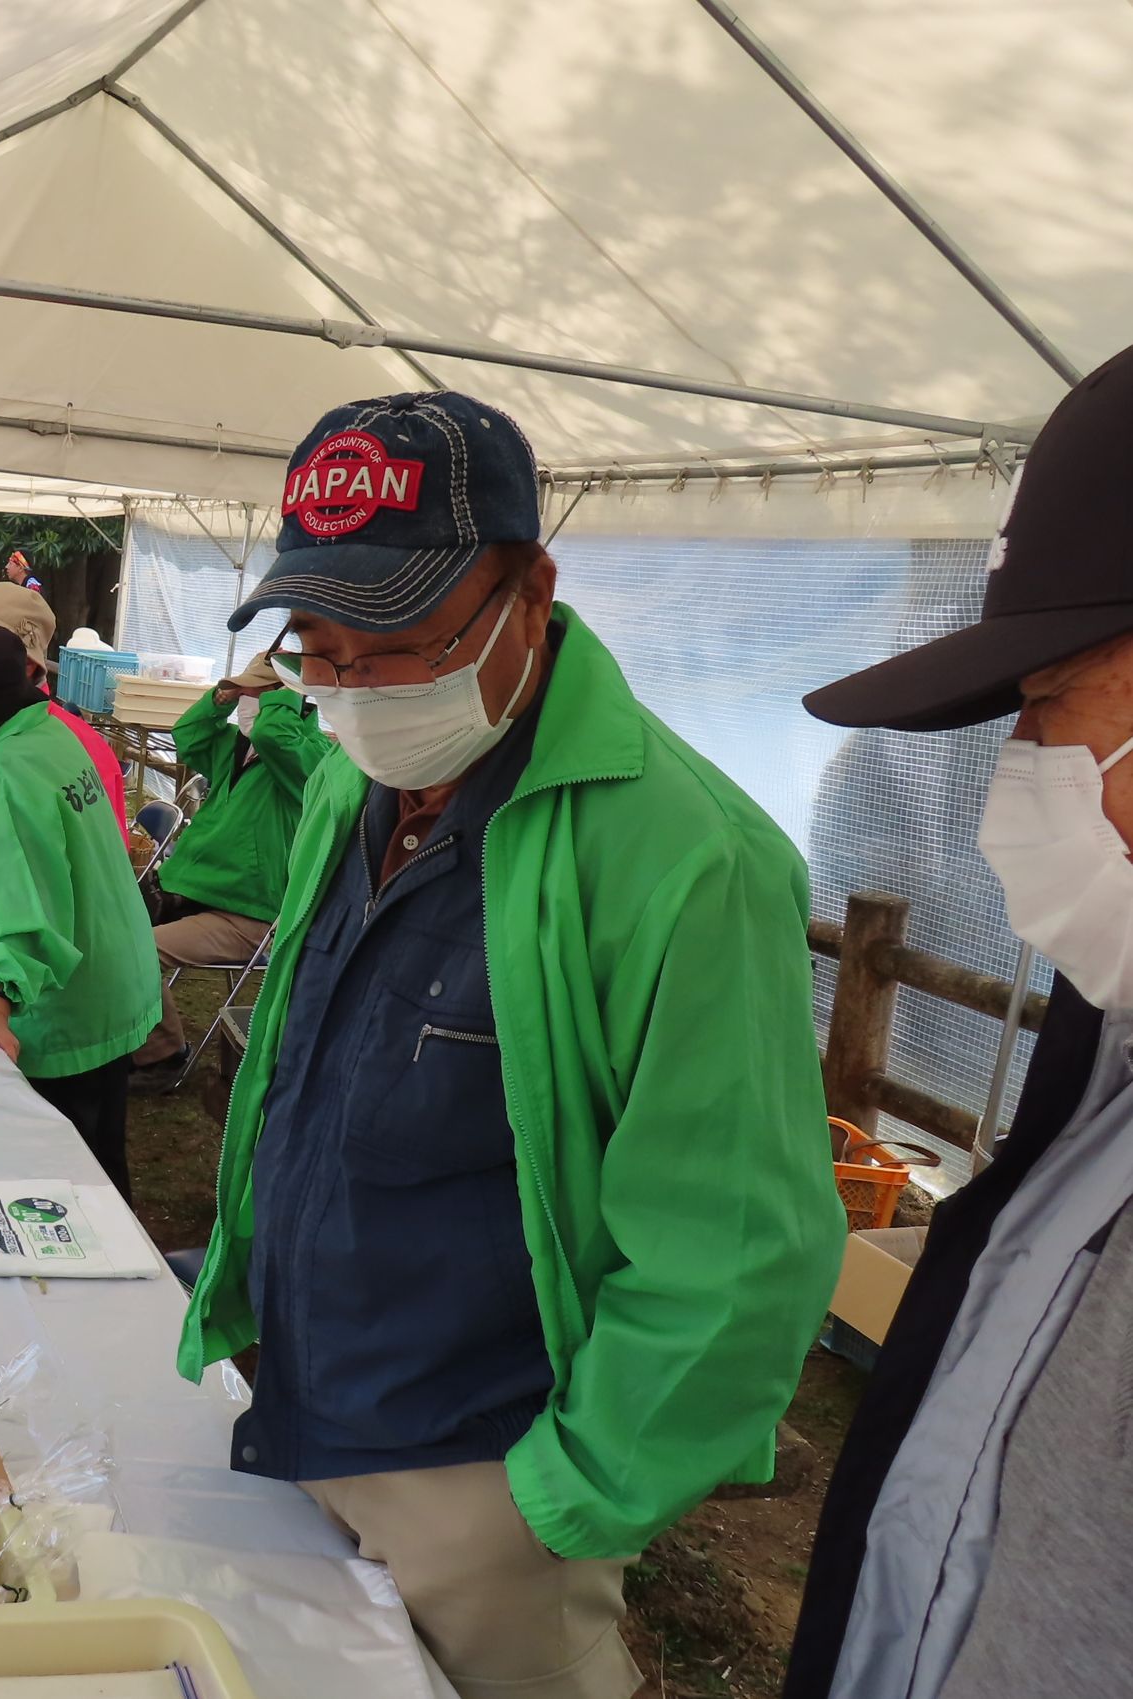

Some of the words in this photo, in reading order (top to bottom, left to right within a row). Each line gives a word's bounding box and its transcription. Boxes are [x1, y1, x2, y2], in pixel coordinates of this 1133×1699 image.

[310, 448, 327, 468] THE
[328, 436, 375, 453] COUNTRY
[370, 450, 382, 464] OF
[287, 466, 409, 505] JAPAN
[304, 508, 367, 532] COLLECTION
